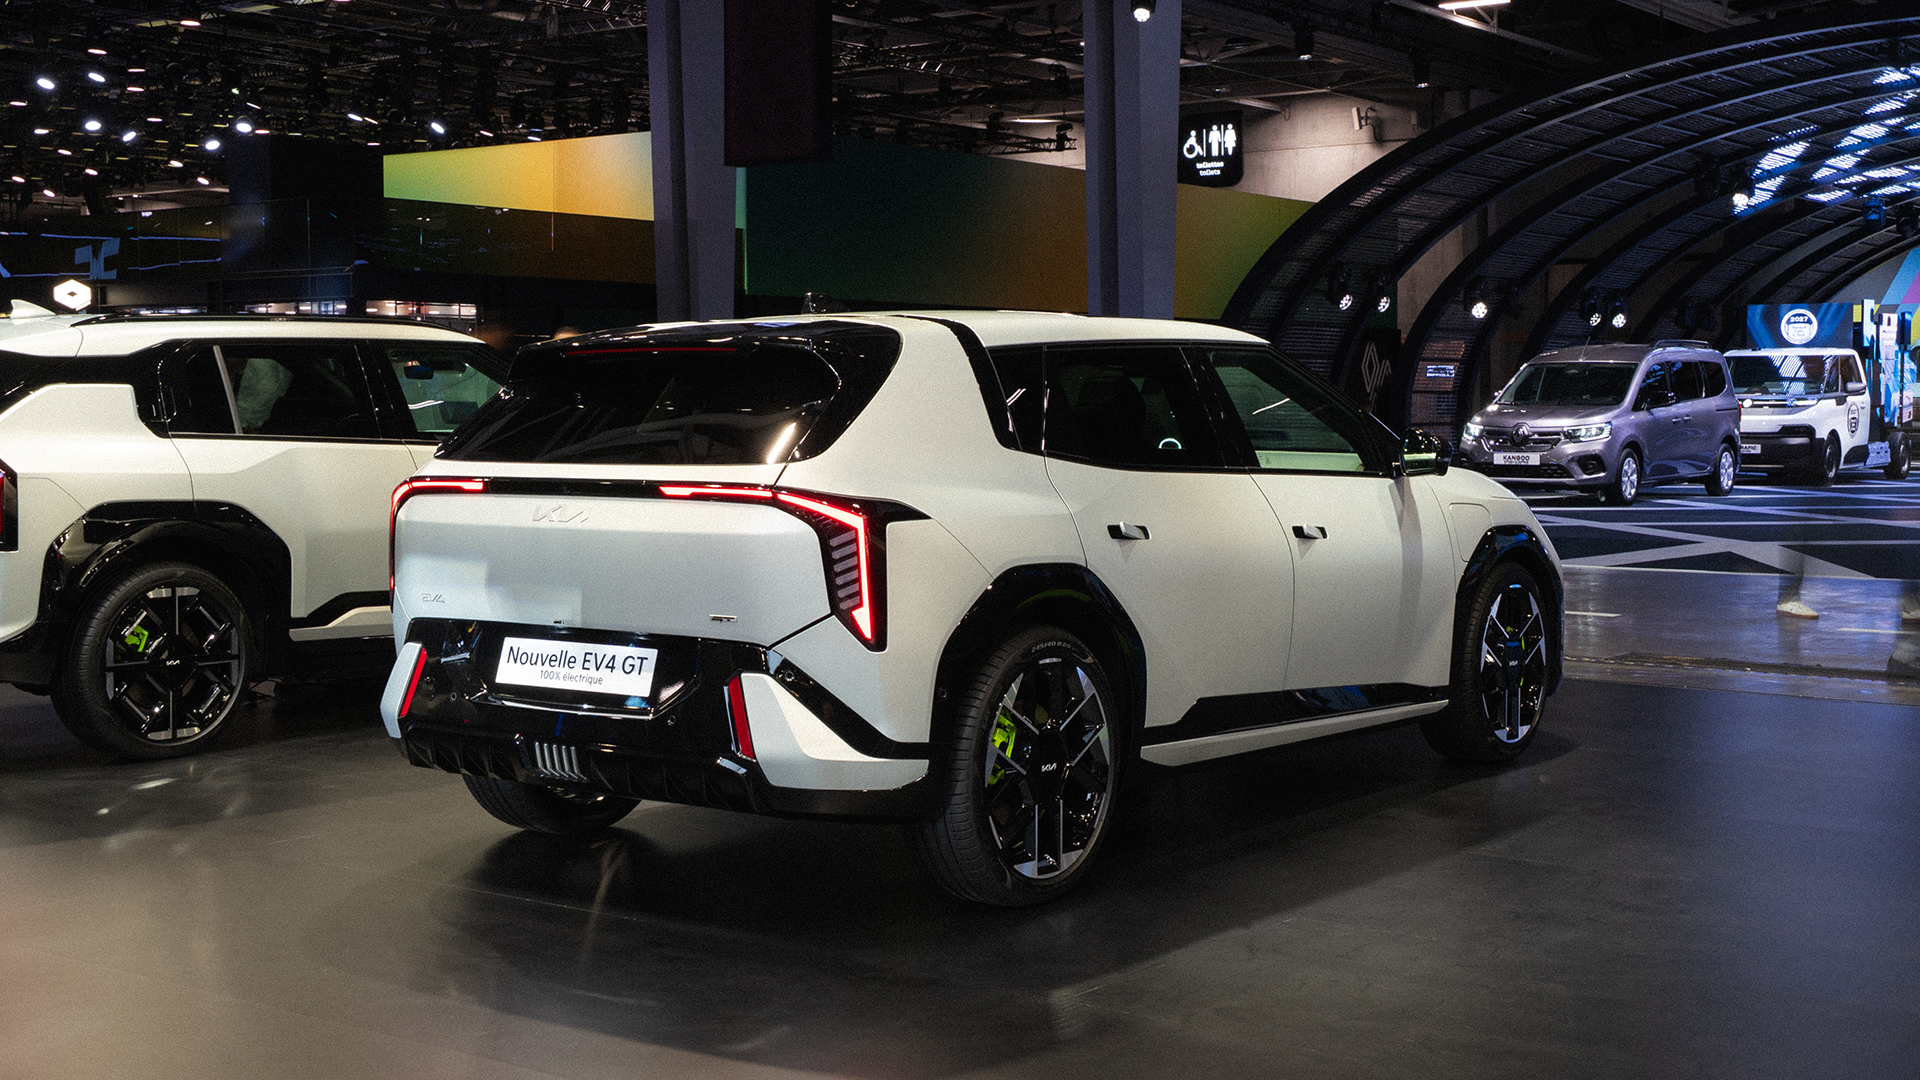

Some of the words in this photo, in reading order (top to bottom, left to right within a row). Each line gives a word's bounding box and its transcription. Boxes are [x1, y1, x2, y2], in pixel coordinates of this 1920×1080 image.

[507, 646, 577, 669] Nouvelle
[582, 652, 616, 673] EV4
[622, 655, 648, 675] GT
[540, 670, 561, 681] 100%
[562, 672, 603, 685] électrique
